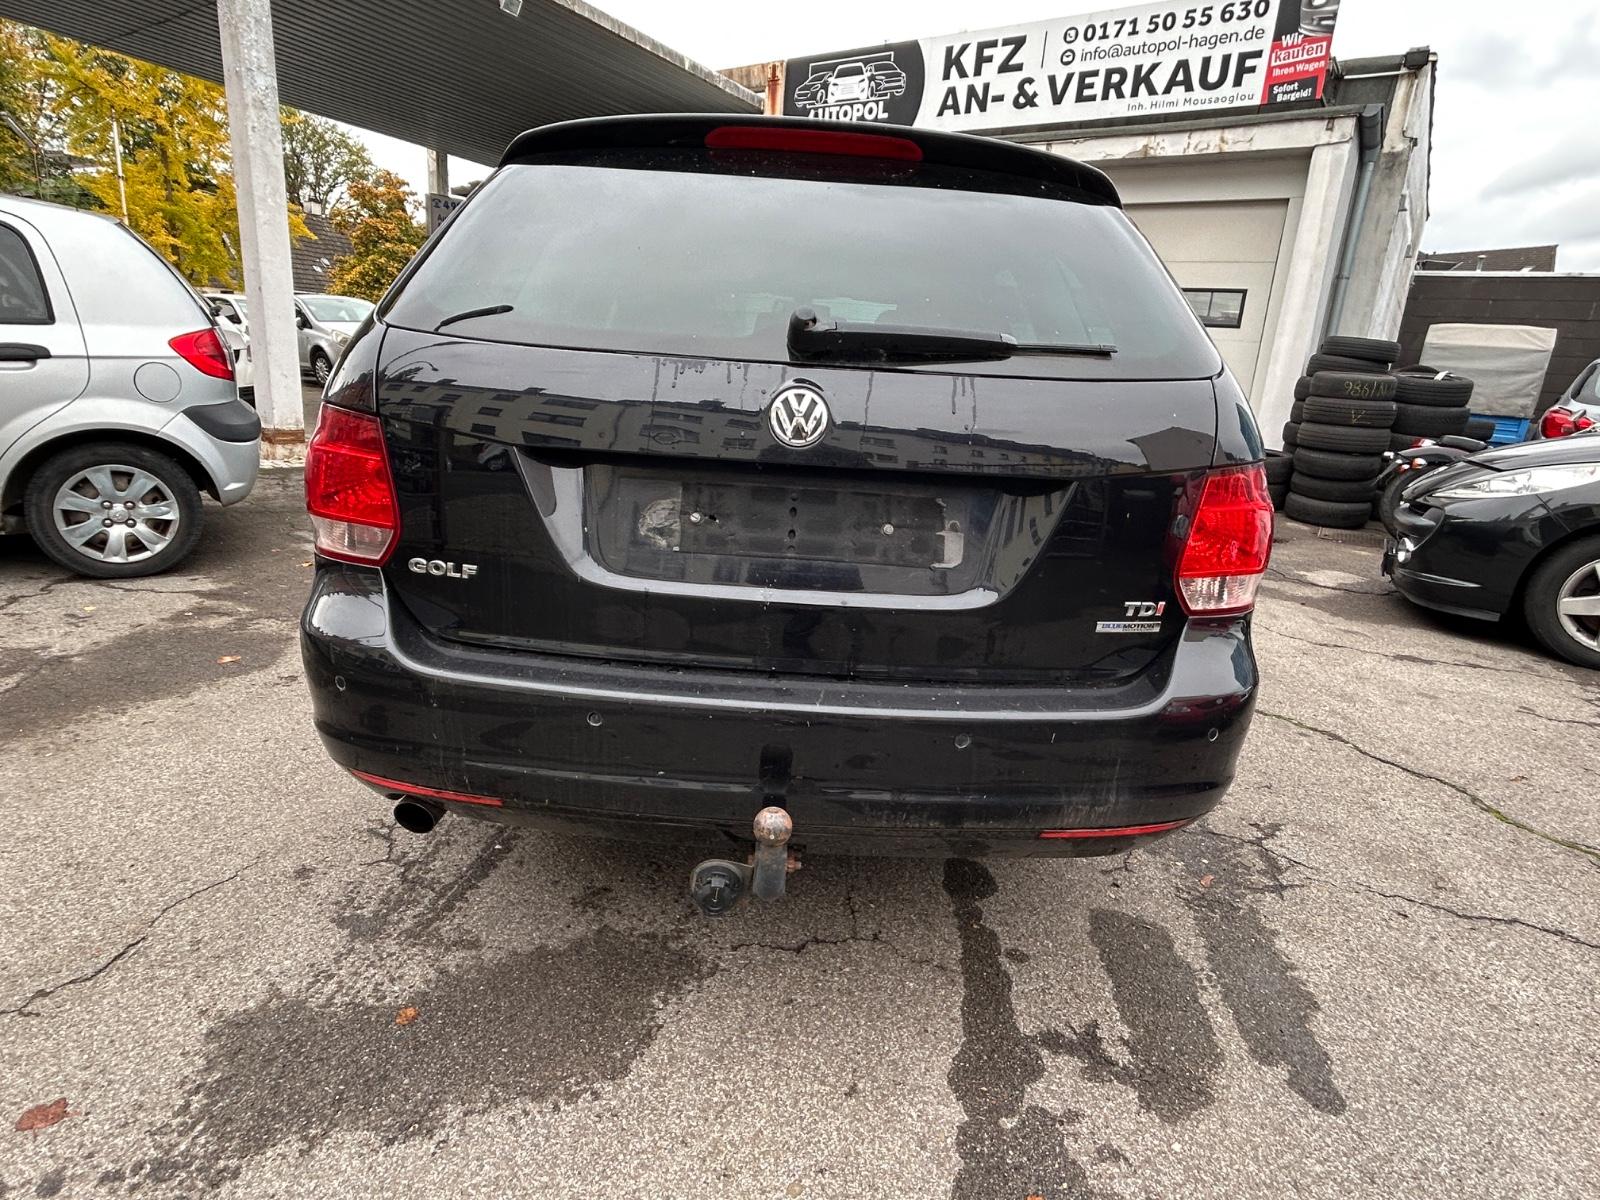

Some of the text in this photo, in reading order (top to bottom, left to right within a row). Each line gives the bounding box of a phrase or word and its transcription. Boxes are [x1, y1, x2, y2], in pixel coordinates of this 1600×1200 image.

[1083, 0, 1270, 42] 0171 50 55 630
[1080, 25, 1265, 62] info@autopol-hagen.de
[1281, 32, 1304, 48] Wir
[942, 34, 1028, 81] KFZ
[1273, 44, 1324, 63] kaufen
[1296, 60, 1325, 72] Wagen
[936, 49, 1264, 117] AN- & VERKAUF
[1273, 82, 1298, 94] Sofort
[1127, 93, 1255, 112] Inh. Hilmi Mousaoglou
[1276, 88, 1312, 102] Bargeld!
[408, 557, 478, 579] GOLF
[1124, 601, 1166, 617] TDI
